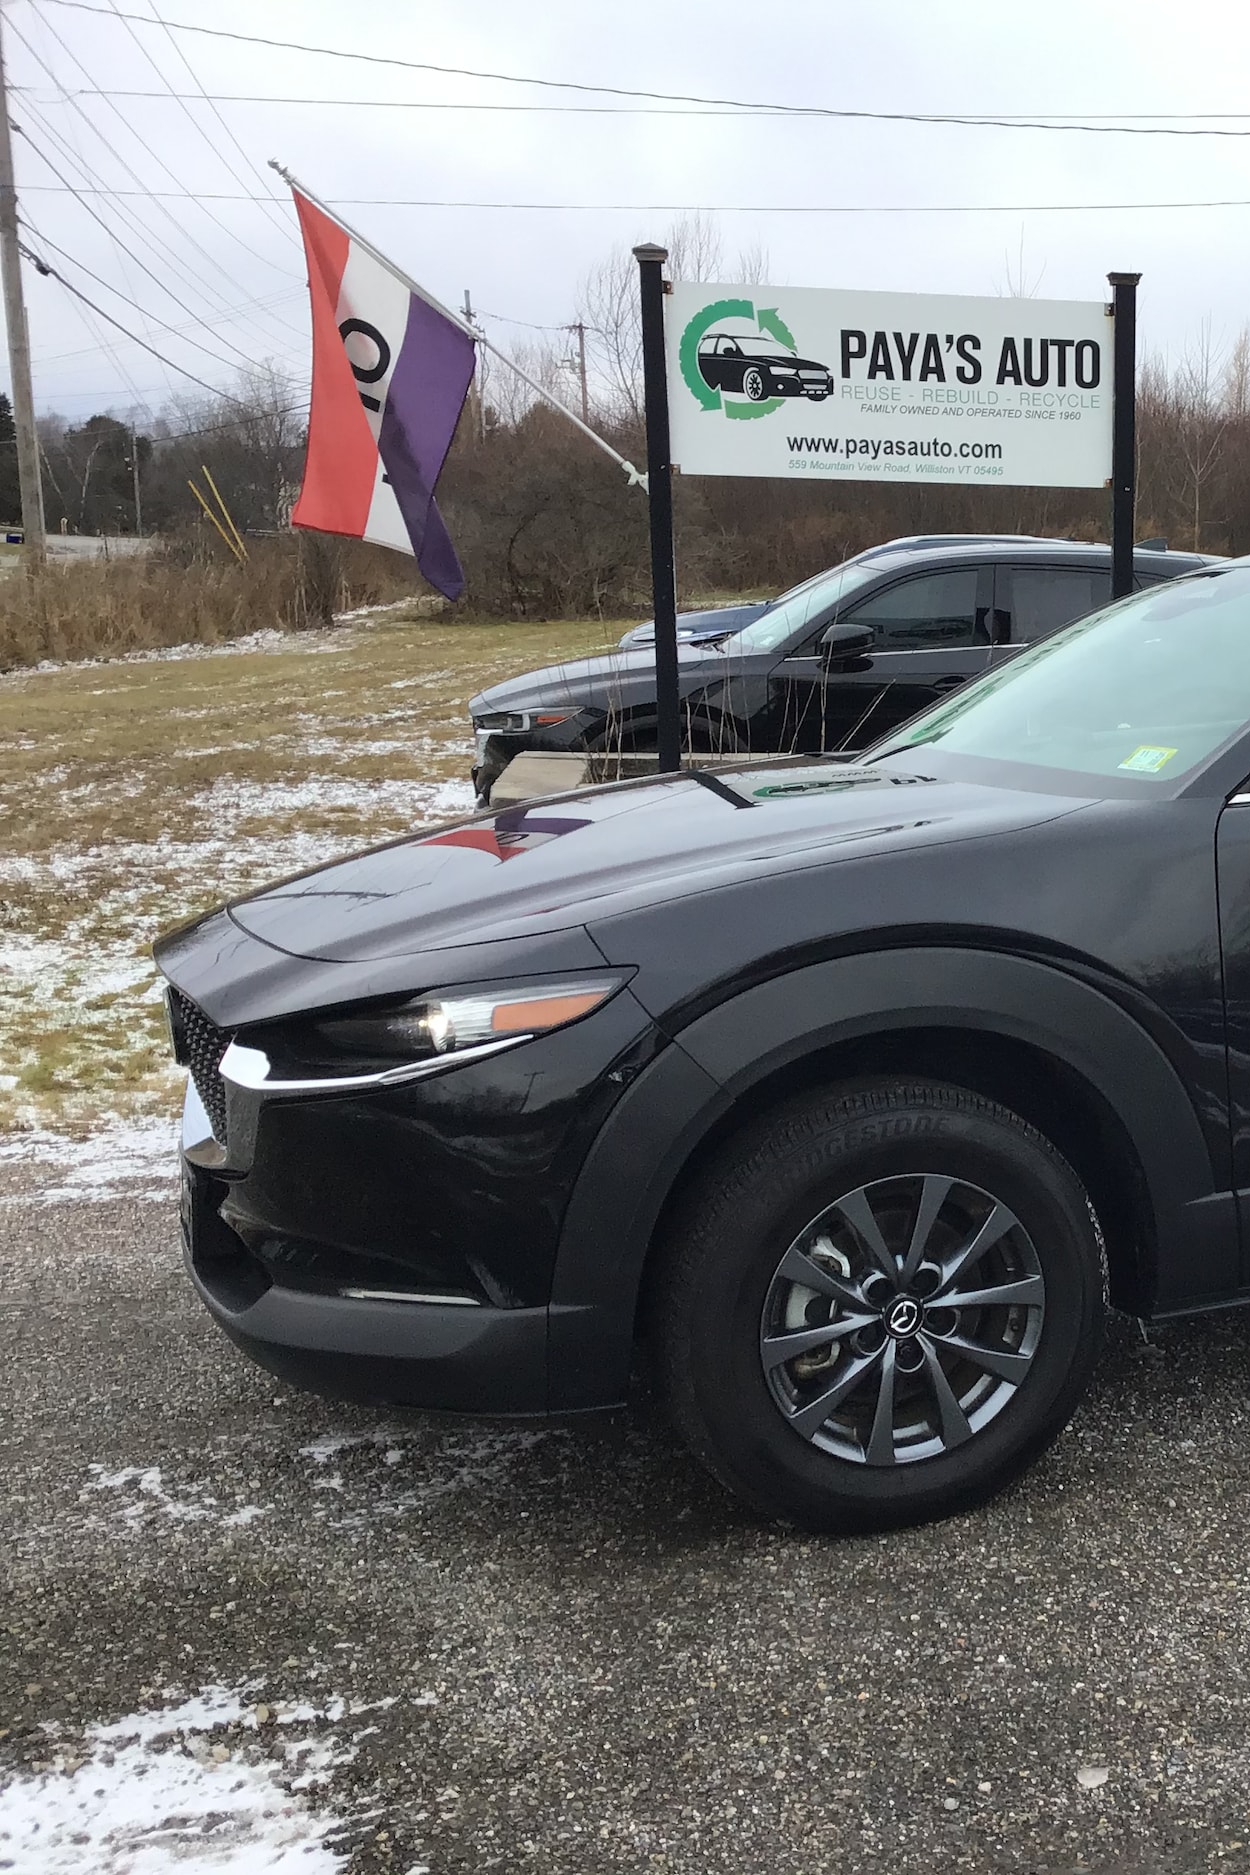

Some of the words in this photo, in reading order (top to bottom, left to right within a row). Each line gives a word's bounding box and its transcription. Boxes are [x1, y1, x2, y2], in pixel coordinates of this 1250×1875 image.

[840, 329, 982, 385] PAYA'S
[996, 336, 1101, 389] AUTO
[841, 385, 901, 401] REUSE
[922, 389, 999, 405] REBUILD
[1019, 392, 1100, 409] RECYCLE
[860, 403, 897, 414] FAMILY
[899, 405, 940, 416] OWNED
[942, 407, 964, 417] AND
[966, 408, 1022, 418] OPERATED
[1024, 410, 1056, 420] SINCE
[1059, 411, 1081, 421] 1960
[787, 436, 1003, 460] www.payasauto.com
[788, 460, 807, 469] 559
[809, 460, 854, 471] Mountain
[857, 462, 881, 472] View
[883, 463, 911, 474] Road,
[915, 464, 955, 474] Williston
[957, 465, 972, 475] VT
[973, 466, 1004, 476] 05495
